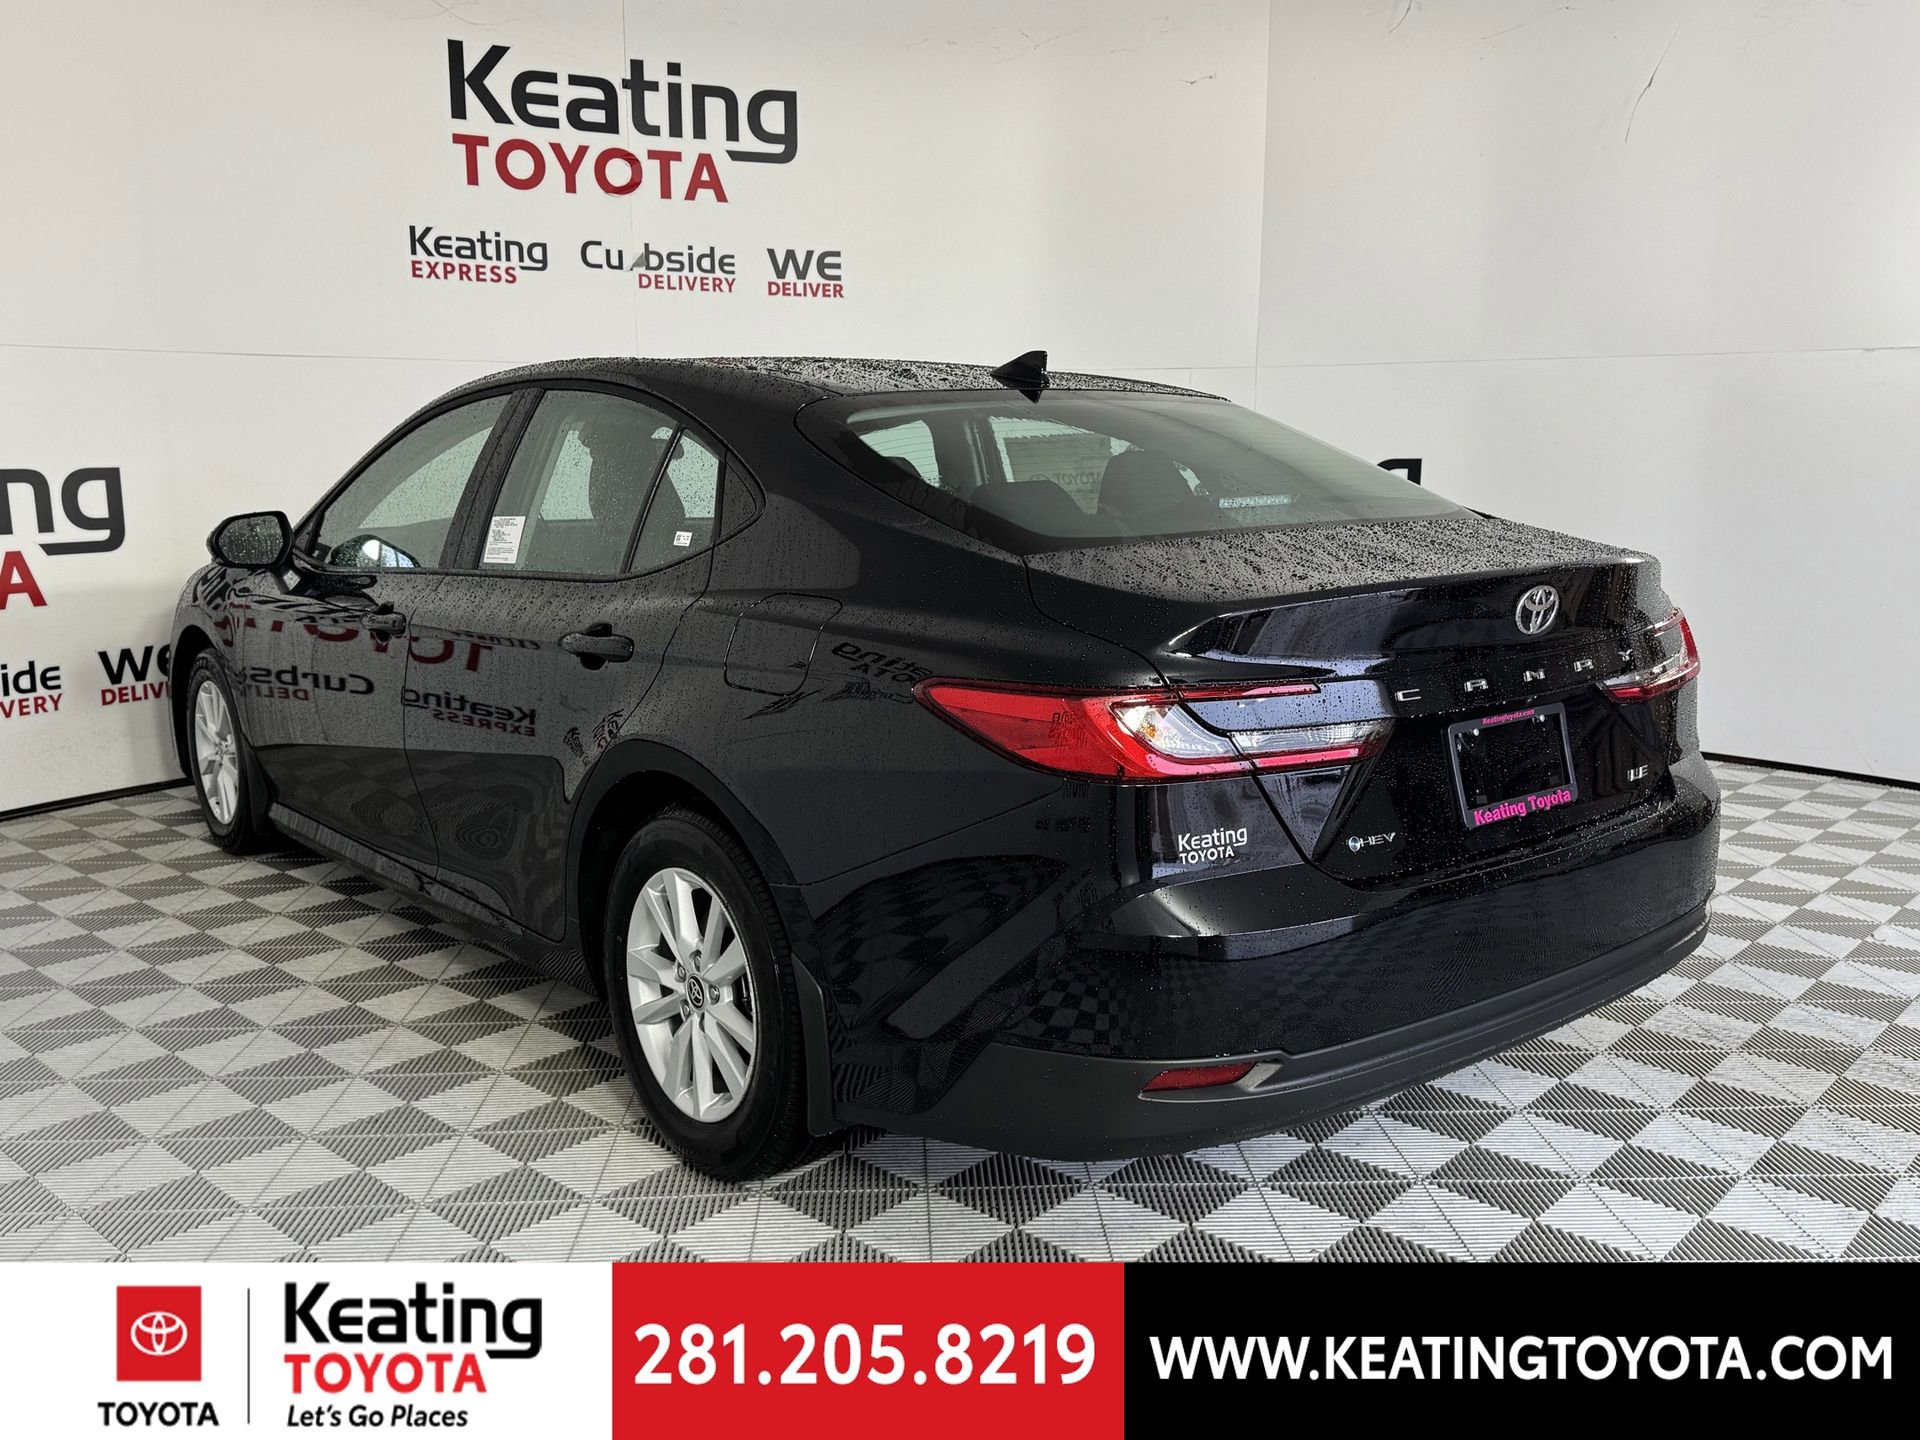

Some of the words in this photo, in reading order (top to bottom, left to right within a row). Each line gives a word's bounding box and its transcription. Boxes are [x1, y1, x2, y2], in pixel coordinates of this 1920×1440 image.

[447, 38, 798, 165] Keating
[452, 133, 728, 203] TOYOTA
[409, 225, 548, 271] Keating
[581, 240, 735, 275] Cubside
[411, 260, 517, 284] EXPRESS
[767, 248, 842, 281] WE
[638, 273, 736, 293] DELIVERY
[767, 281, 844, 298] DELIVER
[1395, 649, 1634, 702] CAMRY
[1627, 764, 1649, 782] LE
[1474, 802, 1527, 826] Keating
[1527, 788, 1572, 811] Toyota
[1178, 827, 1248, 852] Keating
[1359, 832, 1396, 847] HEV
[1179, 845, 1235, 865] TOYOTA
